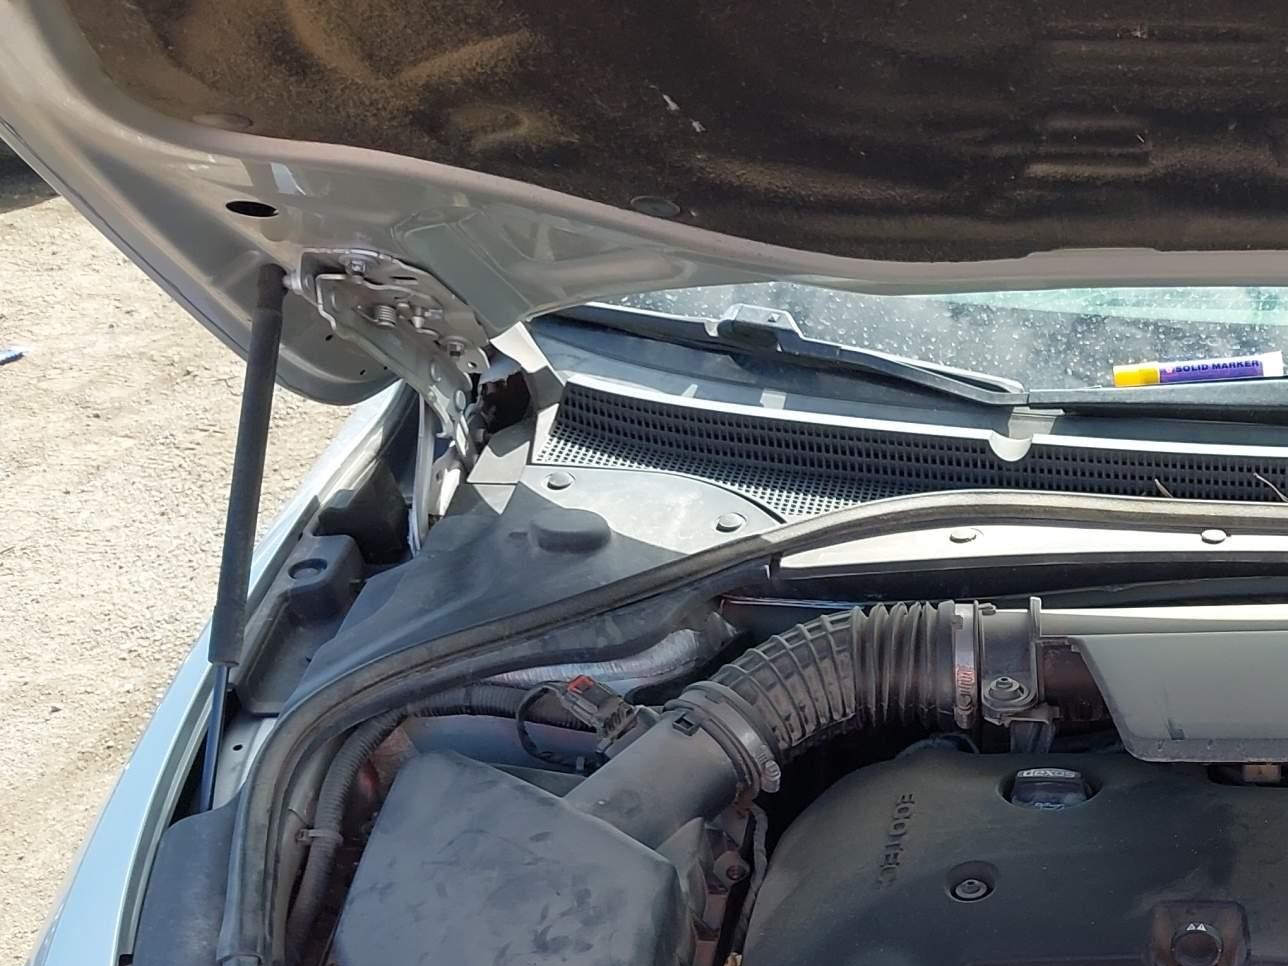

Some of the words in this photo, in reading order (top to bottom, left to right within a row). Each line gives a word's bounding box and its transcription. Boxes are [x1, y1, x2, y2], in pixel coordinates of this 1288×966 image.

[1175, 363, 1209, 373] SOLID
[1212, 360, 1260, 370] MARKER
[1021, 768, 1077, 778] dexos
